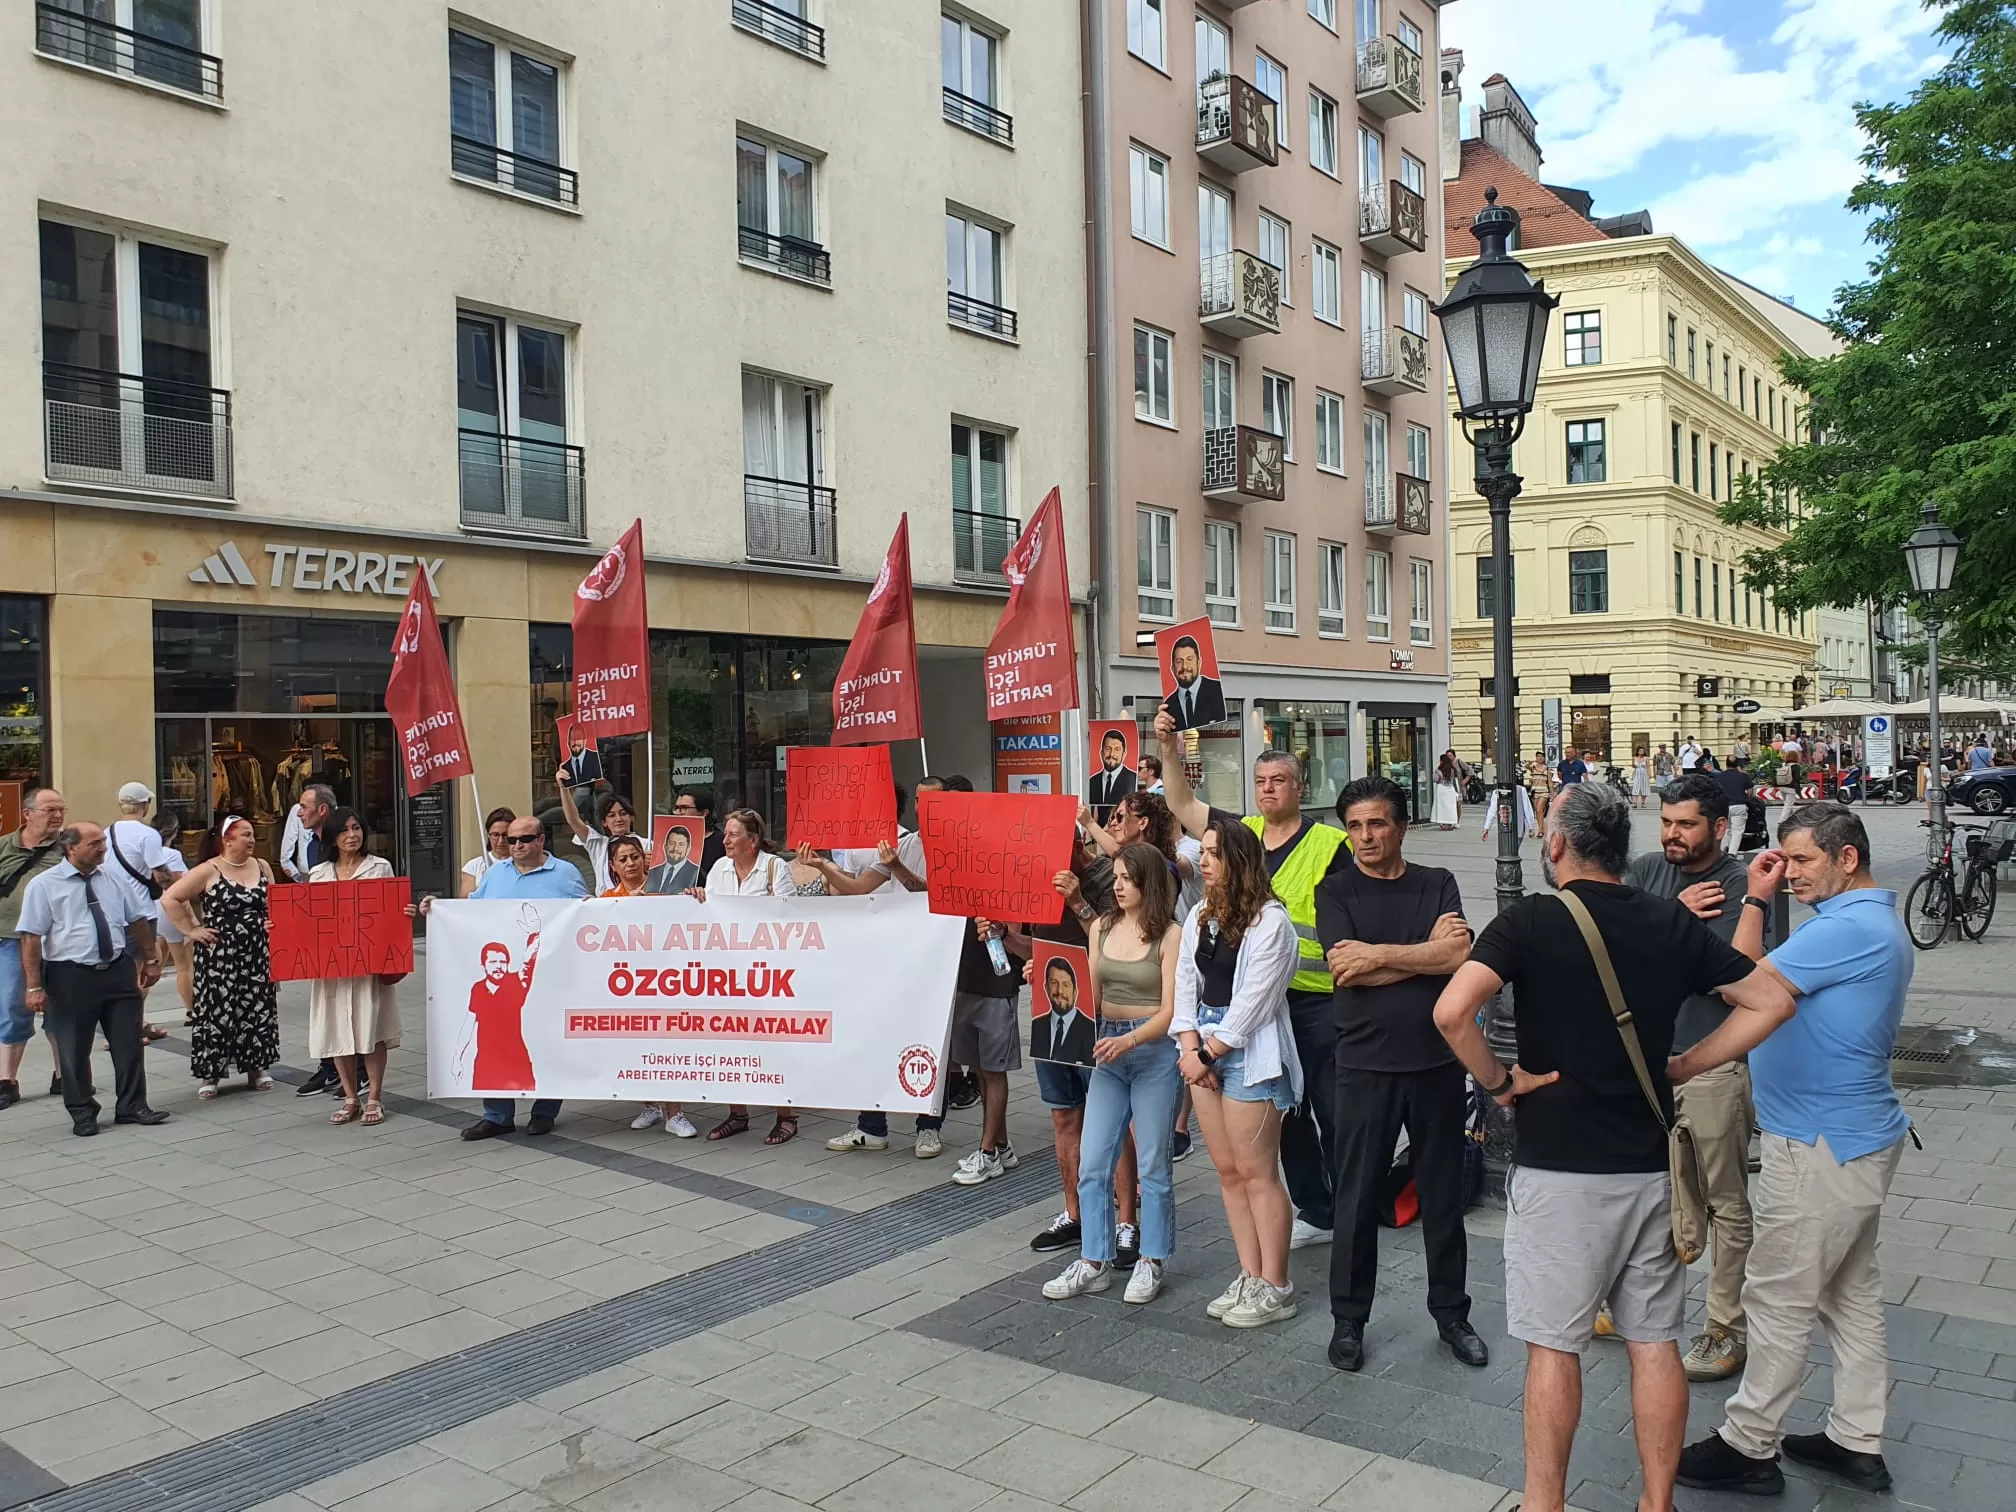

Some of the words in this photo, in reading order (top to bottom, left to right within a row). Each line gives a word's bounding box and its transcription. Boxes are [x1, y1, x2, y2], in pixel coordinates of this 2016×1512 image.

[265, 543, 445, 598] TERREX
[1390, 649, 1414, 661] TOMMY
[1021, 714, 1053, 725] wirkt?
[997, 735, 1059, 750] TAKALP
[683, 765, 713, 776] TERREX
[788, 748, 871, 783] Freiheit
[790, 800, 897, 848] Abgeordneten
[926, 800, 981, 839] Ende
[1007, 802, 1054, 842] der
[932, 839, 1048, 880] politischen
[268, 880, 412, 918] FREIHEIT
[317, 915, 376, 948] FÜR
[576, 924, 653, 952] CAN
[662, 921, 825, 951] ATALAY'A
[269, 946, 320, 981] CAN
[325, 943, 413, 978] ATALAY
[607, 961, 796, 998] ÖZGÜRLÜK
[569, 1015, 661, 1032] FREIHEIT
[666, 1012, 704, 1033] FÜR
[709, 1016, 749, 1034] CAN
[753, 1017, 828, 1036] ATALAY
[641, 1053, 691, 1066] TÜRKİYE
[694, 1053, 716, 1068] İŞÇİ
[719, 1055, 762, 1068] PARTİSİ
[909, 1059, 929, 1075] TİP
[617, 1069, 715, 1082] ARBEITERPARTEI
[719, 1071, 741, 1083] DER
[744, 1070, 784, 1085] TÜRKEI
